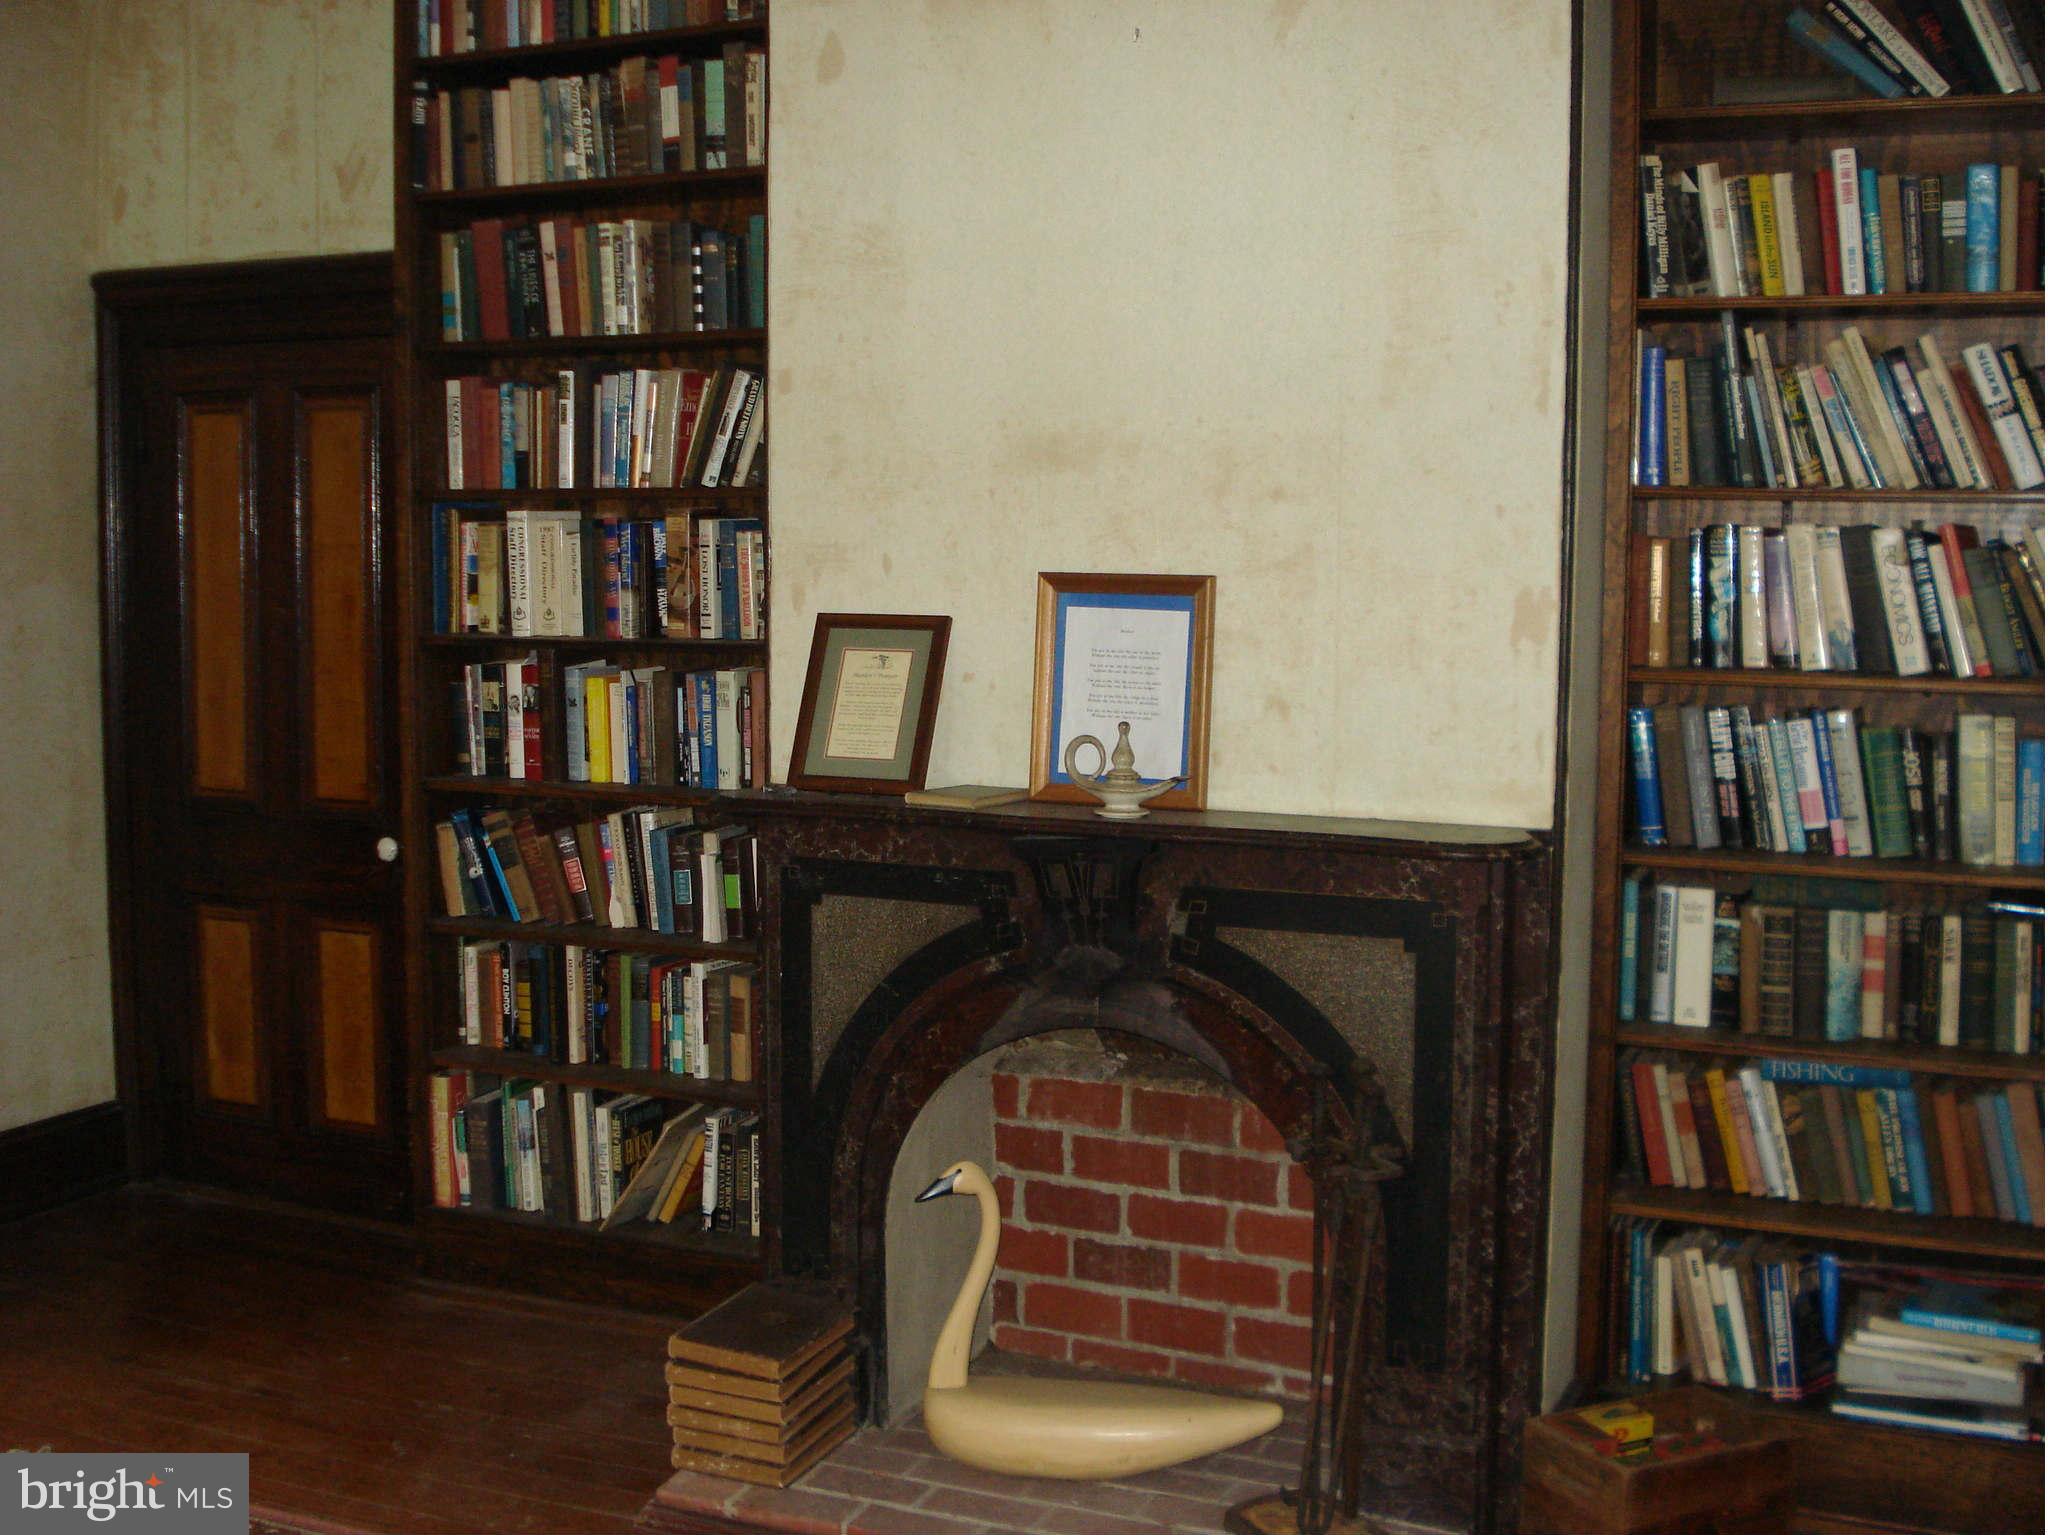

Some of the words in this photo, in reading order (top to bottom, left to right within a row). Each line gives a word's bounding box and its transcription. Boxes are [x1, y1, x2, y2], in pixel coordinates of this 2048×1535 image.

[582, 108, 594, 156] CRANE
[1760, 201, 1772, 234] ISLAND
[1767, 258, 1779, 279] SUN
[1976, 349, 2000, 397] SHADOW
[509, 527, 517, 550] Staff
[518, 527, 527, 600] CONGRESSIONAL
[701, 550, 709, 574] LOST
[701, 576, 709, 613] HONOR
[1882, 545, 1914, 647] ECONOMICS
[702, 694, 712, 712] HIGH
[703, 714, 713, 746] TREASON
[502, 968, 510, 983] BOY
[502, 984, 511, 1015] CLINTON
[1770, 1060, 1855, 1082] FISHING
